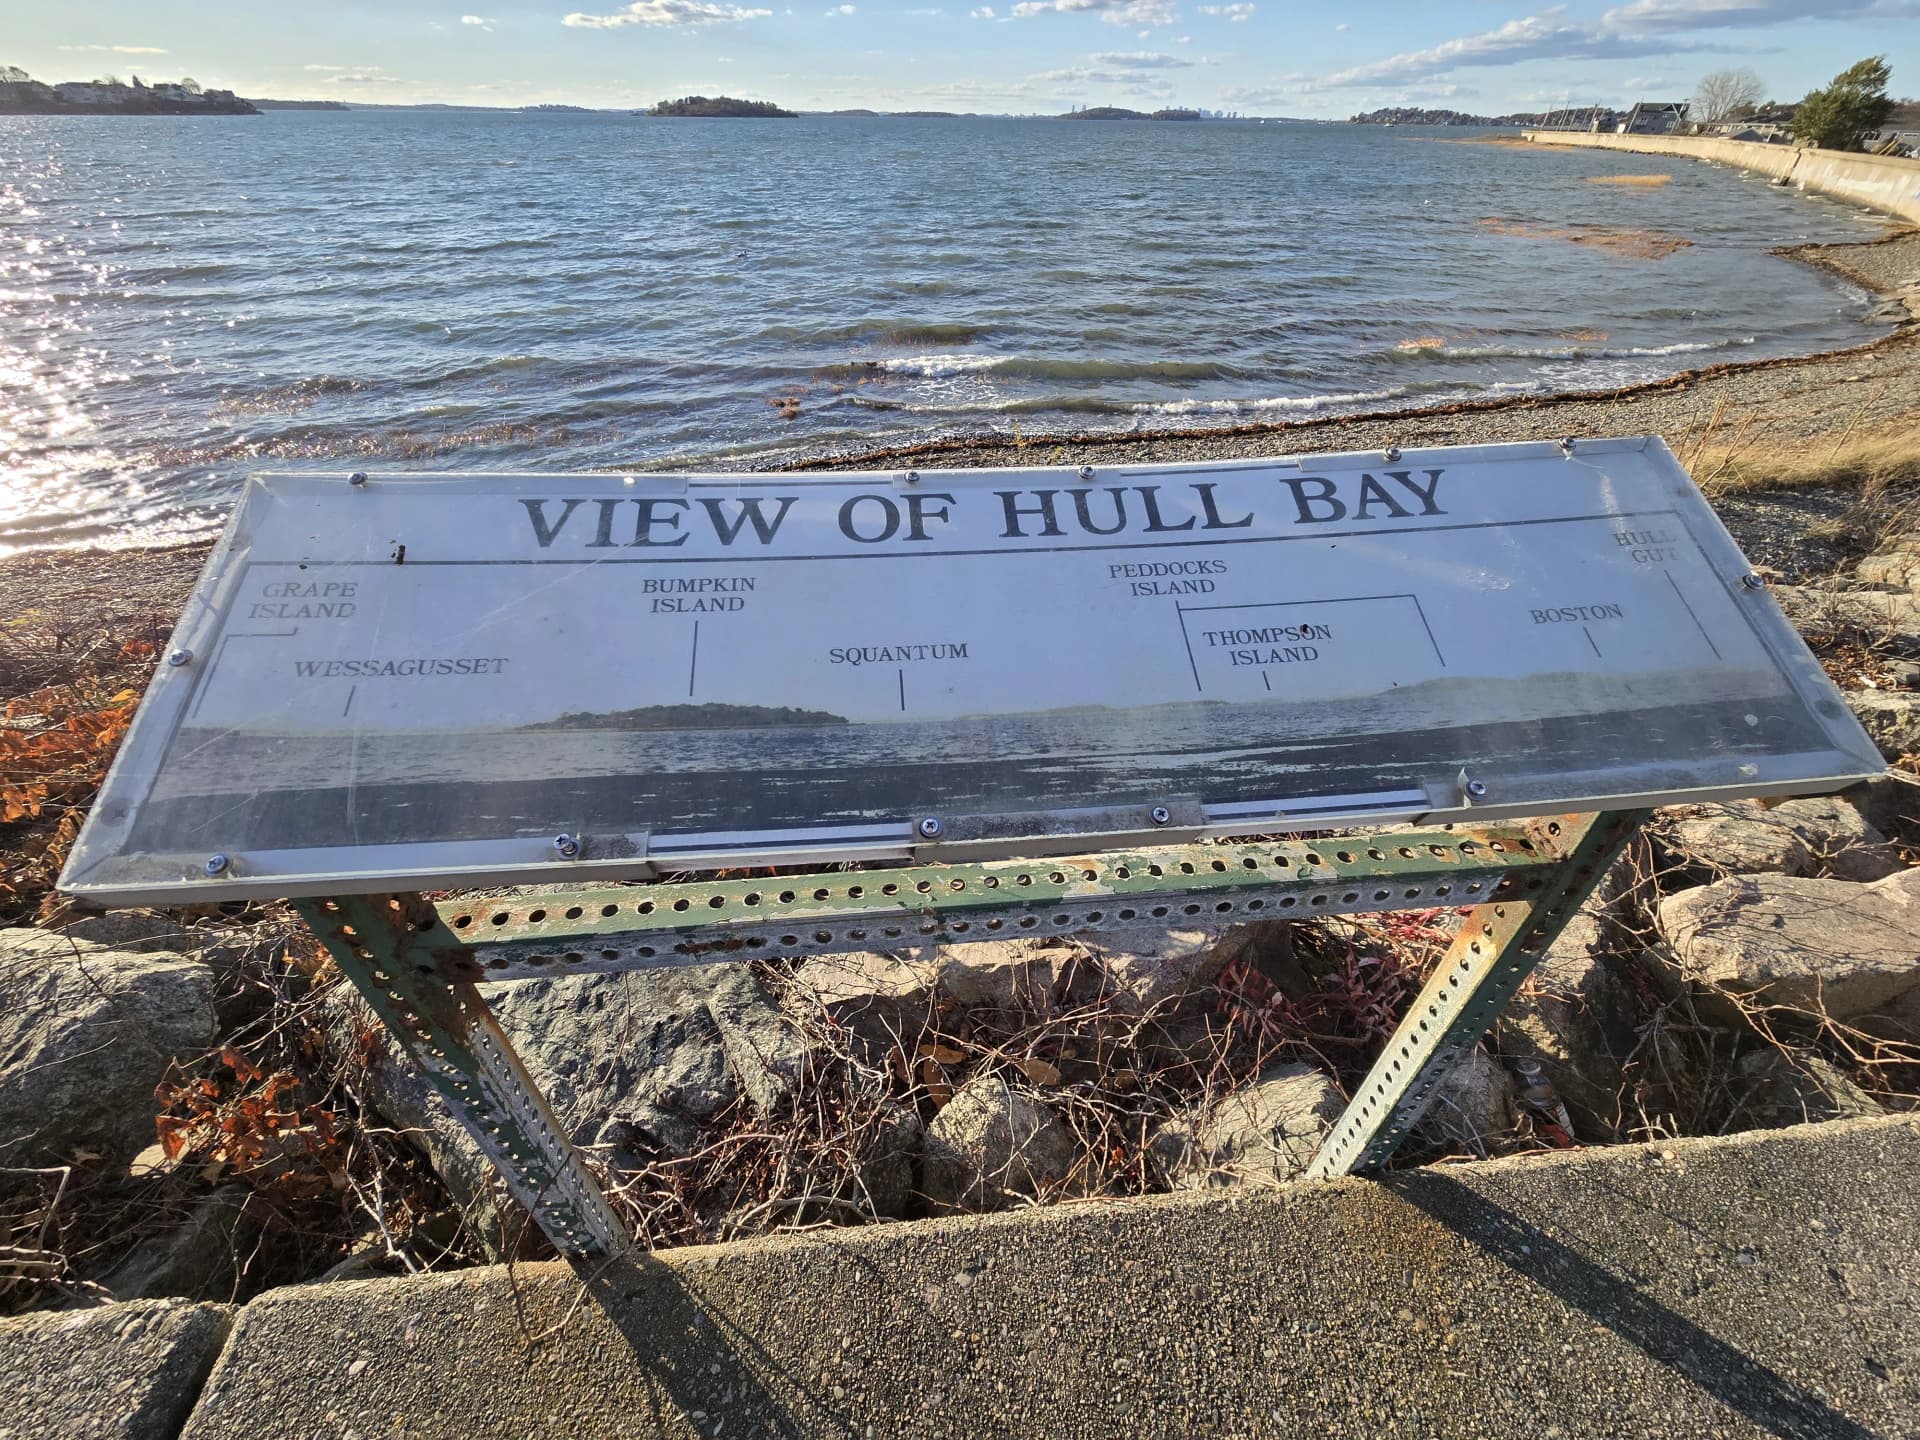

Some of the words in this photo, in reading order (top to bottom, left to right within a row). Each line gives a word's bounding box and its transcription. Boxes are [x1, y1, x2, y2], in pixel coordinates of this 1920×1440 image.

[518, 497, 800, 549] VIEW
[838, 494, 957, 543] OF
[993, 482, 1255, 538] HULL
[1280, 470, 1448, 525] BAY
[1108, 560, 1228, 579] PEDDOCKS
[262, 582, 358, 598] GRAPE
[642, 577, 756, 594] BUMPKIN
[1131, 579, 1216, 597] ISLAND
[248, 602, 357, 619] ISLAND
[650, 597, 746, 613] ISLAND
[1528, 603, 1624, 625] BOSTON
[1203, 624, 1332, 647] THOMPSON
[829, 643, 969, 665] SQUANTUM
[1230, 646, 1319, 667] ISLAND
[294, 658, 509, 678] WESSAGUSSET
